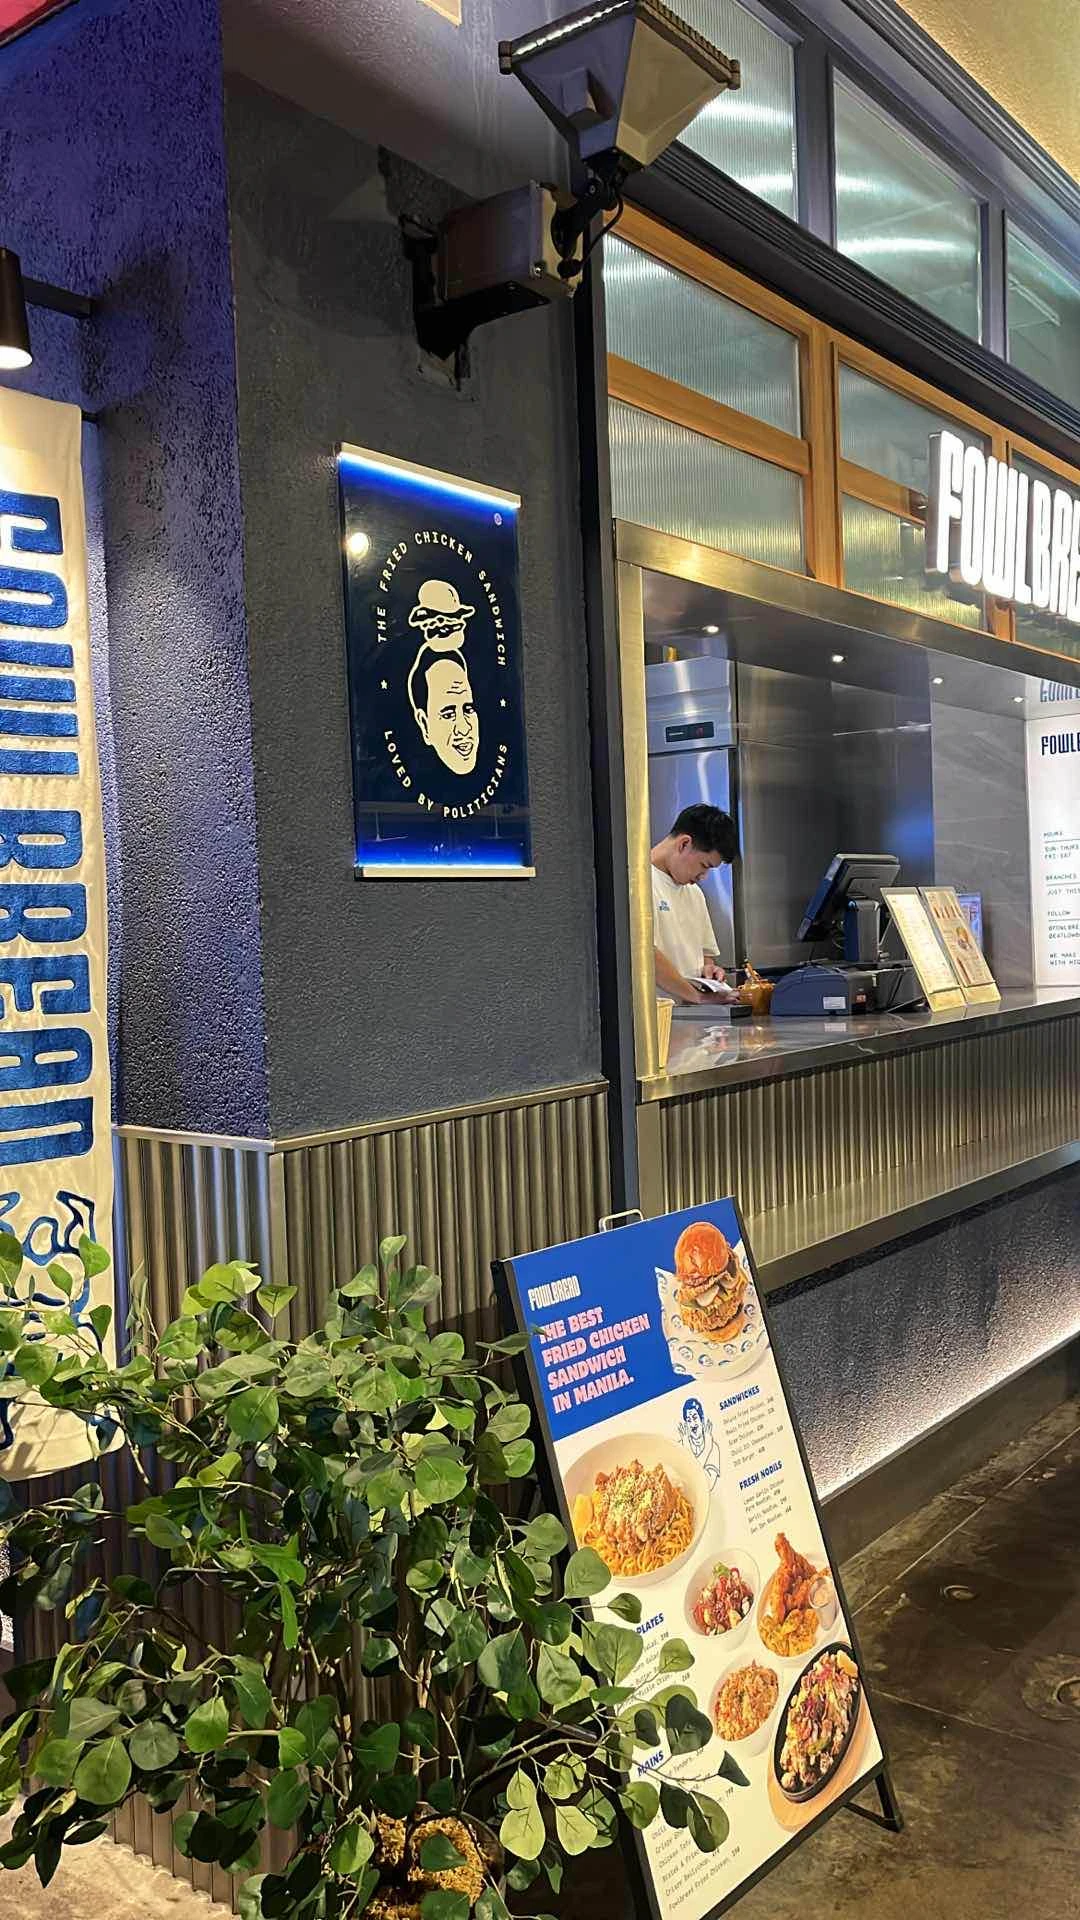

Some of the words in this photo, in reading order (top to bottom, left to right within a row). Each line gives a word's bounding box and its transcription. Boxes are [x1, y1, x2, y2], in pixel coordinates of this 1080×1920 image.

[379, 542, 408, 592] FRIED
[414, 531, 473, 564] CHICKEN
[377, 606, 388, 643] THE
[478, 570, 507, 666] SANDWICH
[384, 730, 412, 788] LOVED
[417, 793, 434, 811] BY
[443, 744, 508, 819] POLITICIANS
[538, 1320, 567, 1344] THE
[567, 1306, 603, 1334] BEST
[541, 1337, 588, 1367] FRIED
[589, 1313, 651, 1349] CHICKEN
[547, 1345, 627, 1391] SANDWICH
[551, 1391, 573, 1414] IN
[573, 1368, 635, 1405] MANILA.
[719, 1385, 760, 1411] SANDWICHES
[739, 1473, 760, 1491] FRESH
[637, 1750, 664, 1777] MAINS
